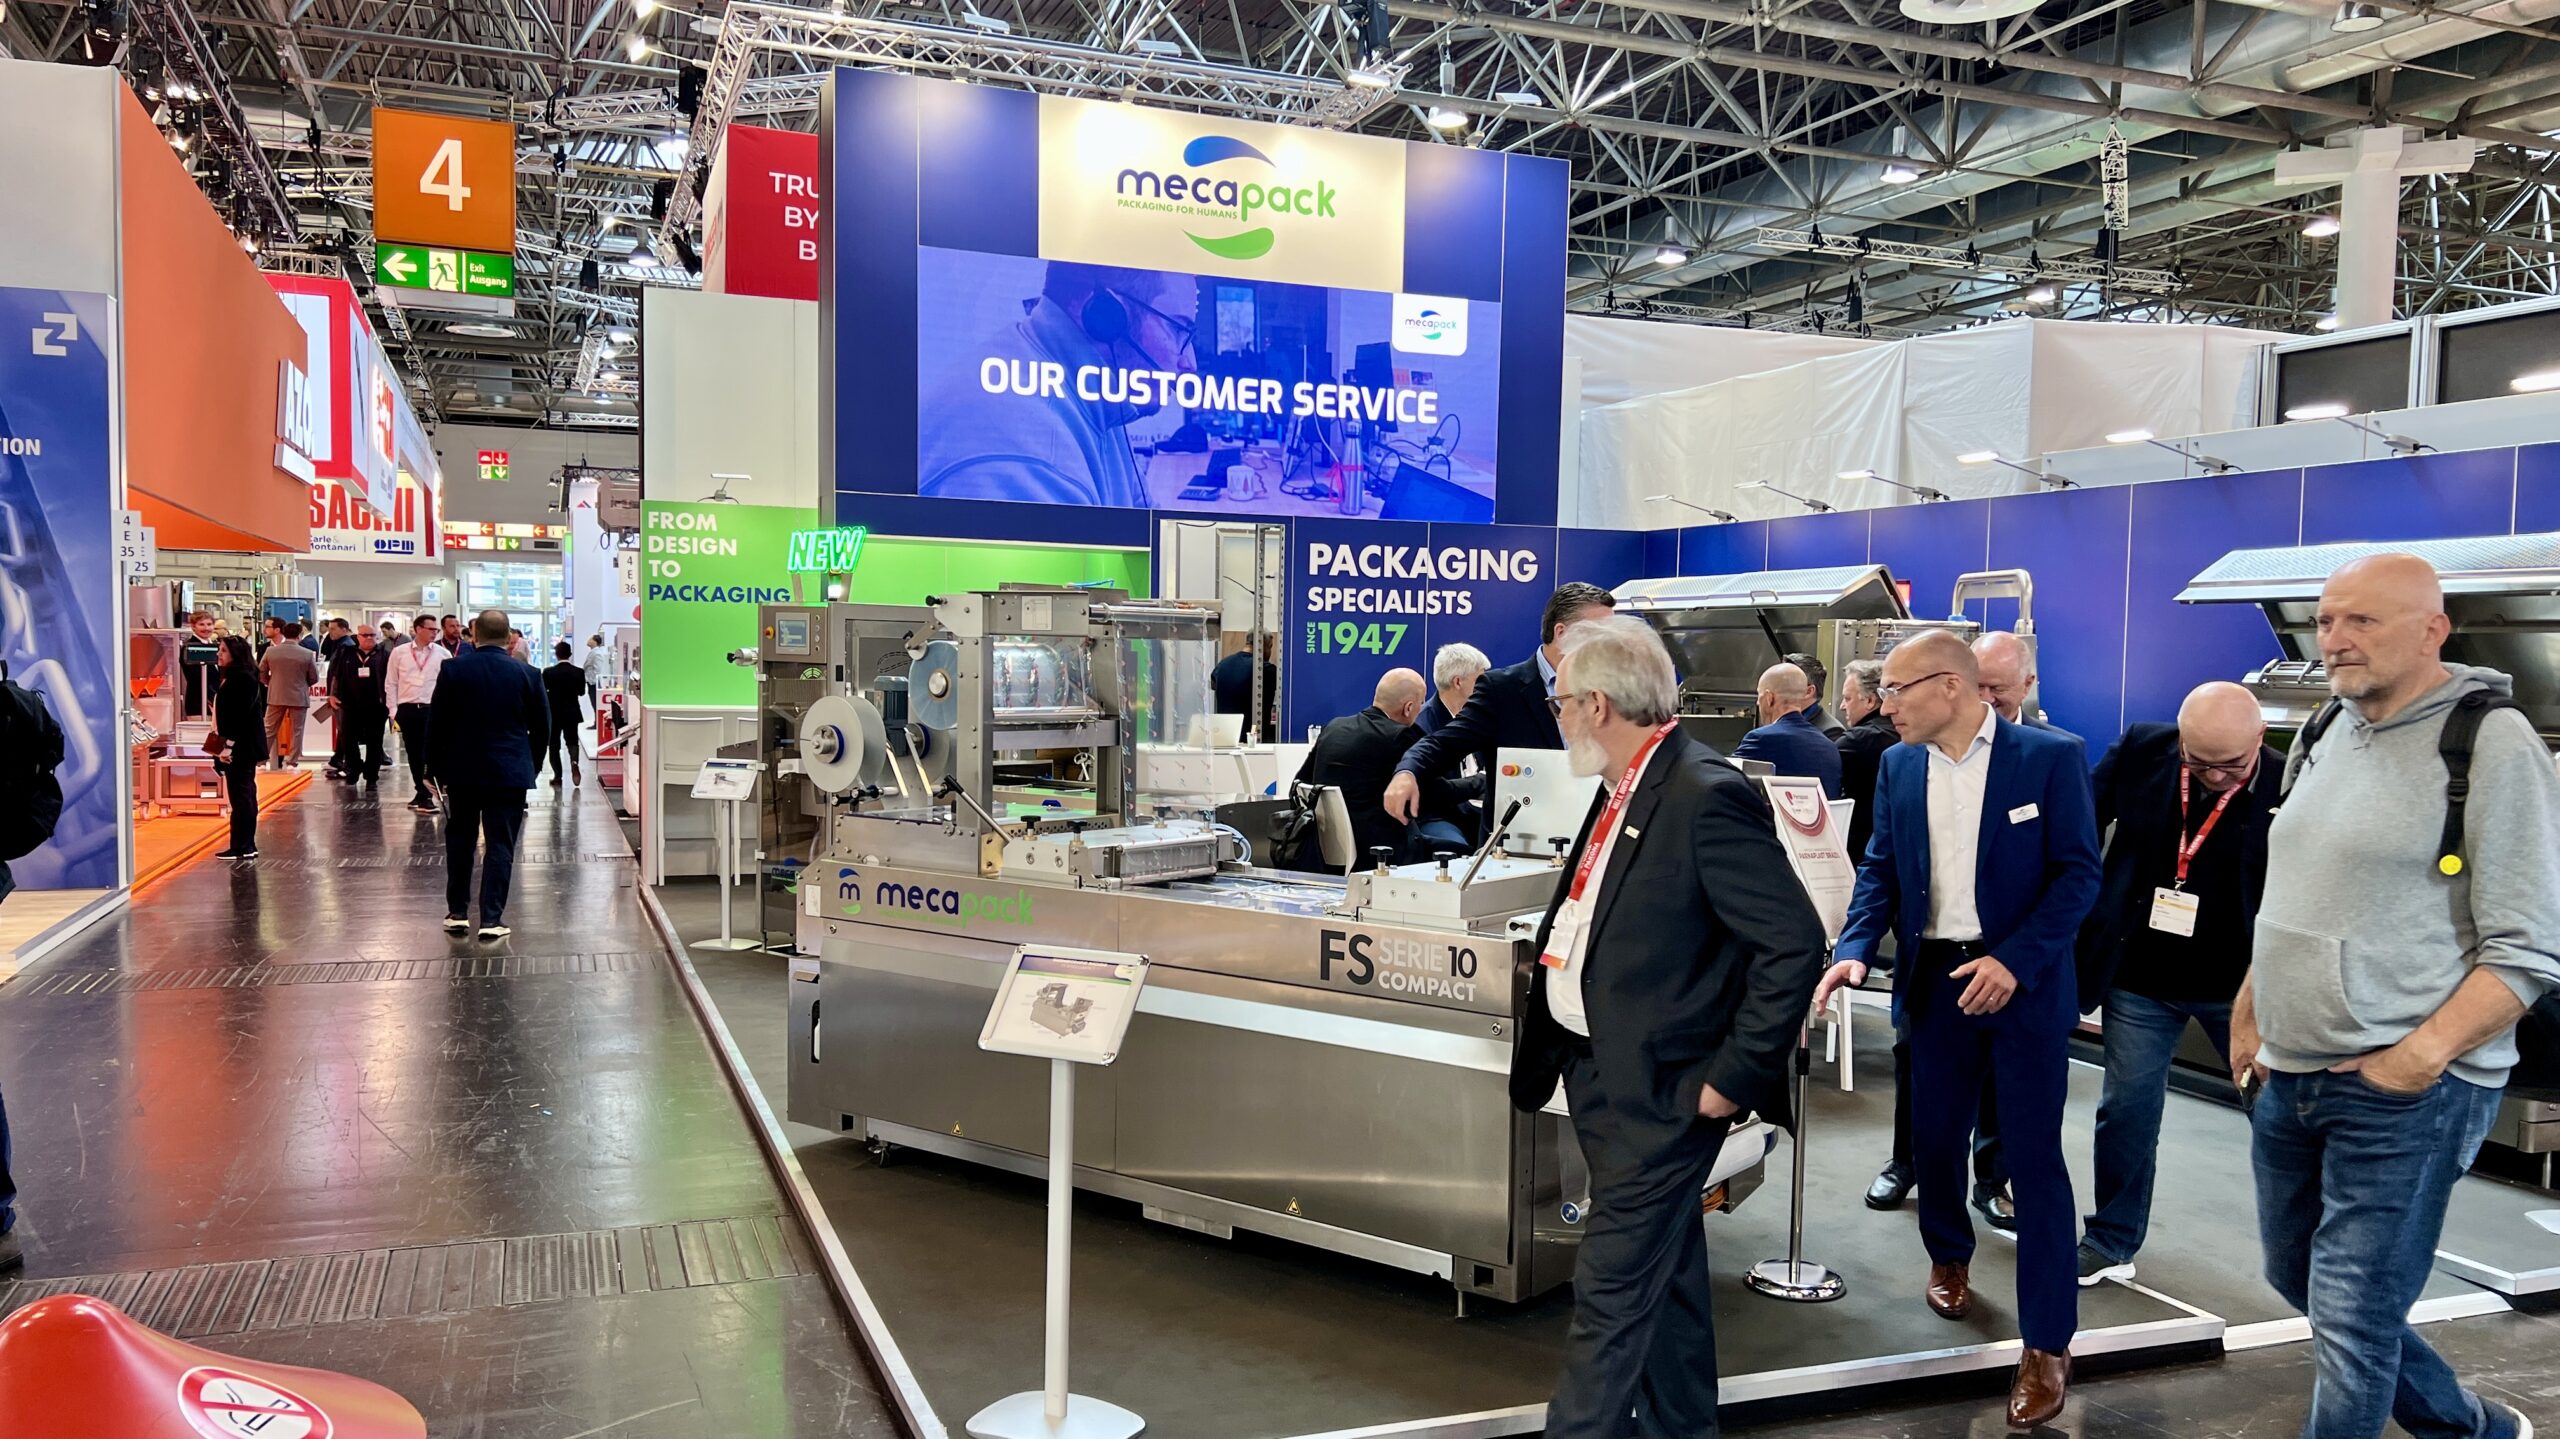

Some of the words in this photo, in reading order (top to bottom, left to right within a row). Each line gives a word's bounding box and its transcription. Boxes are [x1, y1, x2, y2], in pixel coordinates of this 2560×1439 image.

[420, 138, 471, 212] 4
[1117, 168, 1336, 222] mecapack
[1117, 198, 1174, 213] PACKAGING
[1176, 204, 1194, 216] FOR
[1196, 208, 1238, 220] HUMANS
[470, 263, 485, 273] Exit
[470, 274, 508, 288] Ausgang
[1404, 318, 1457, 331] mecapack
[979, 356, 1065, 398] OUR
[1076, 364, 1283, 415] CUSTOMER
[1293, 380, 1438, 425] SERVICE
[0, 437, 41, 456] ION
[123, 515, 131, 525] 4
[648, 511, 718, 532] FROM
[124, 530, 131, 541] E
[648, 535, 738, 556] DESIGN
[120, 546, 135, 557] 35
[788, 527, 866, 572] NEW
[135, 561, 149, 572] 25
[627, 556, 633, 565] 4
[649, 560, 681, 578] TO
[1308, 543, 1539, 583] PACKAGING
[627, 570, 633, 579] E
[625, 585, 636, 594] 36
[649, 584, 791, 604] PACKAGING
[1307, 586, 1472, 615] SPECIALISTS
[1306, 621, 1316, 654] SINCE
[1317, 621, 1408, 655] 1947
[876, 881, 1035, 929] mecapack
[1320, 929, 1375, 985] FS
[1378, 937, 1443, 972] SERIE
[1447, 945, 1478, 979] 10
[1378, 970, 1477, 1002] COMPACT
